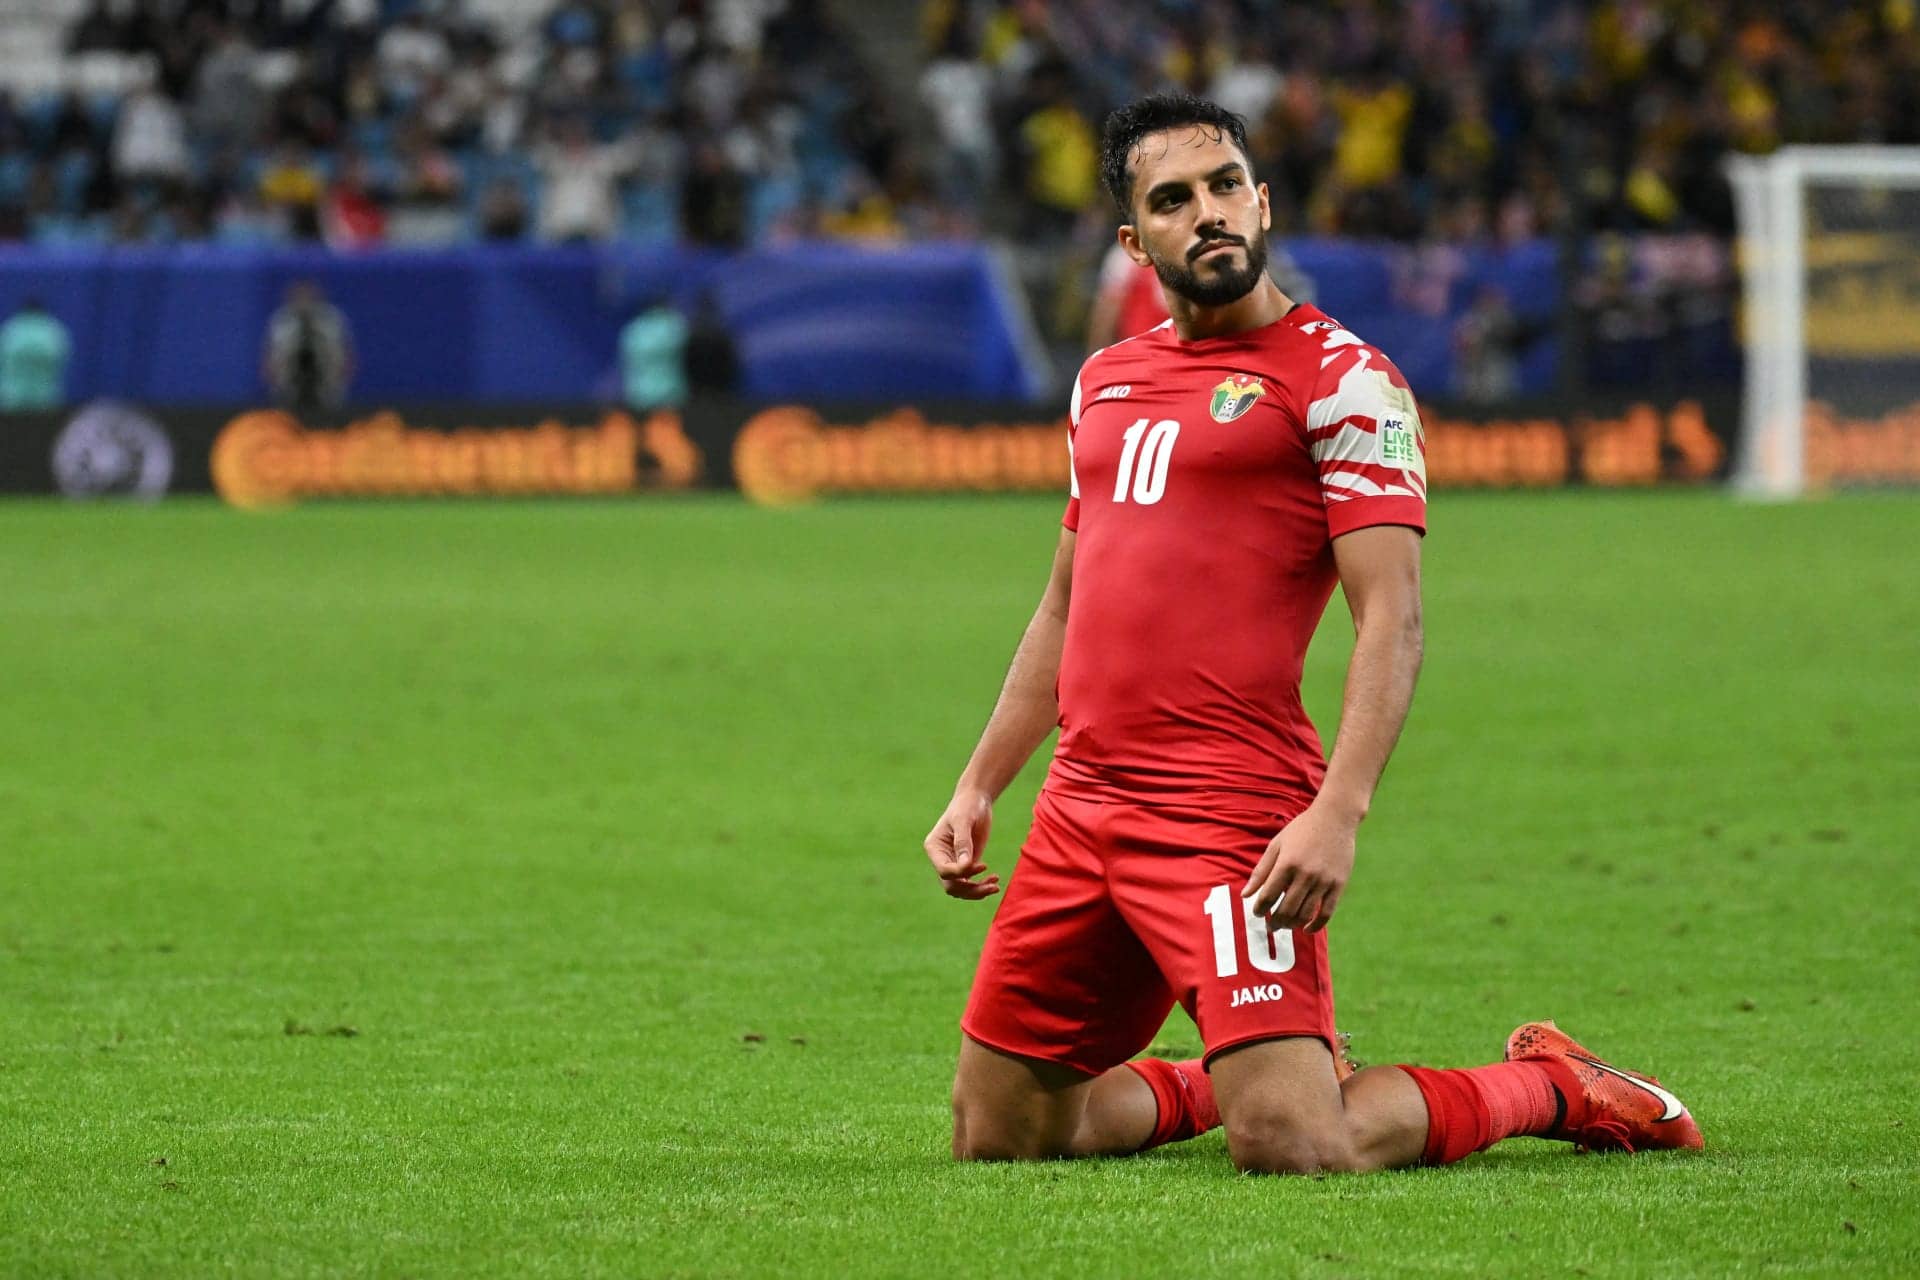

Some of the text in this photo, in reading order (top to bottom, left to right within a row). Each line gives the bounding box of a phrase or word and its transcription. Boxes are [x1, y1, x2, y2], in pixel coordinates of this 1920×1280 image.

[1384, 419, 1403, 430] AFC
[1383, 430, 1412, 447] LIVE
[1112, 418, 1181, 505] 10
[1230, 984, 1283, 1008] JAKO
